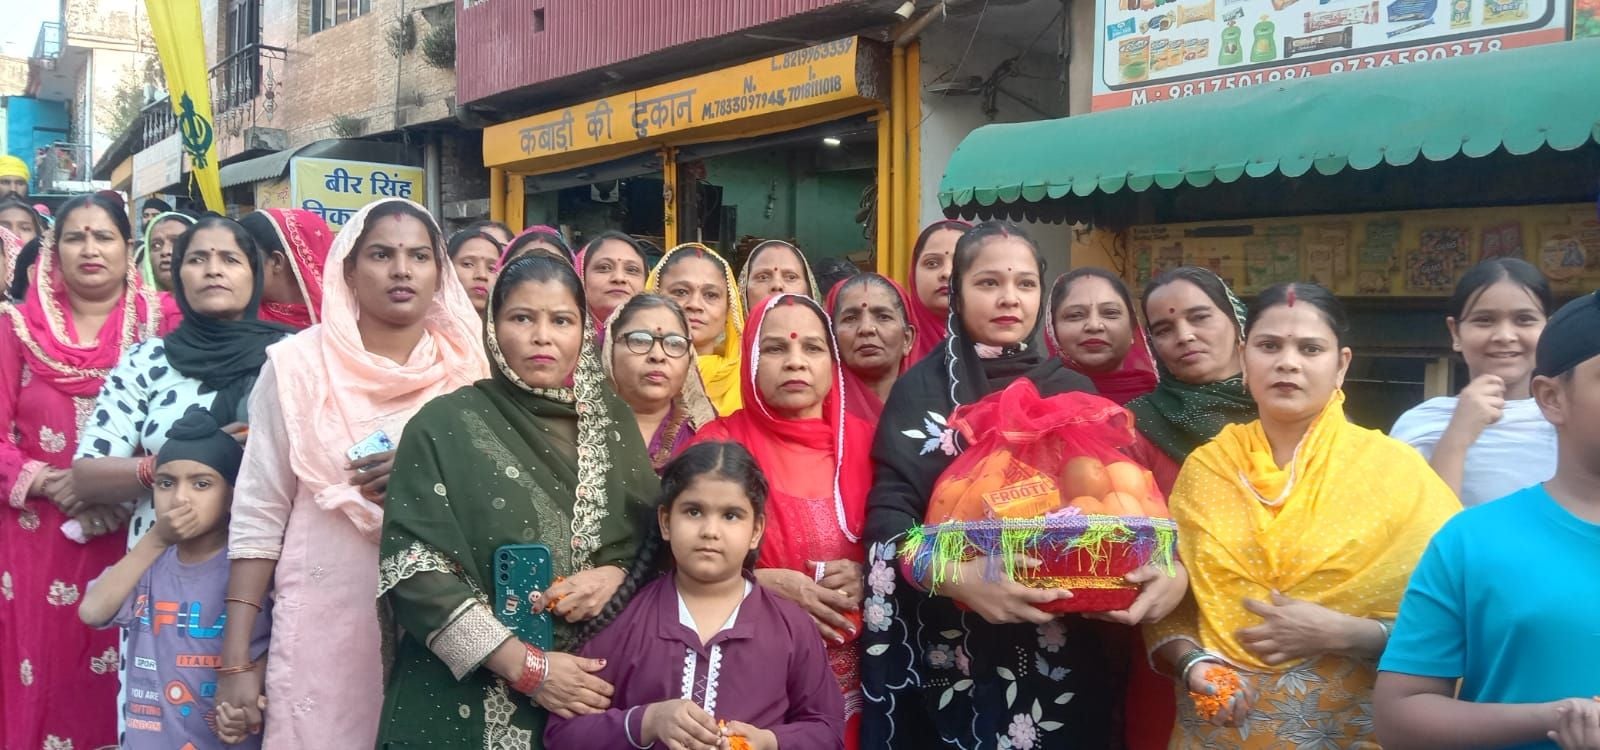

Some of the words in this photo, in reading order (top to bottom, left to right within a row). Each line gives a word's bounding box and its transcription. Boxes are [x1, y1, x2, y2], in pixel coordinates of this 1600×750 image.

[586, 100, 613, 142] की
[324, 168, 363, 194] बीर
[369, 171, 412, 199] सिंह
[990, 484, 1047, 503] FROOTI
[179, 656, 220, 666] ITALY
